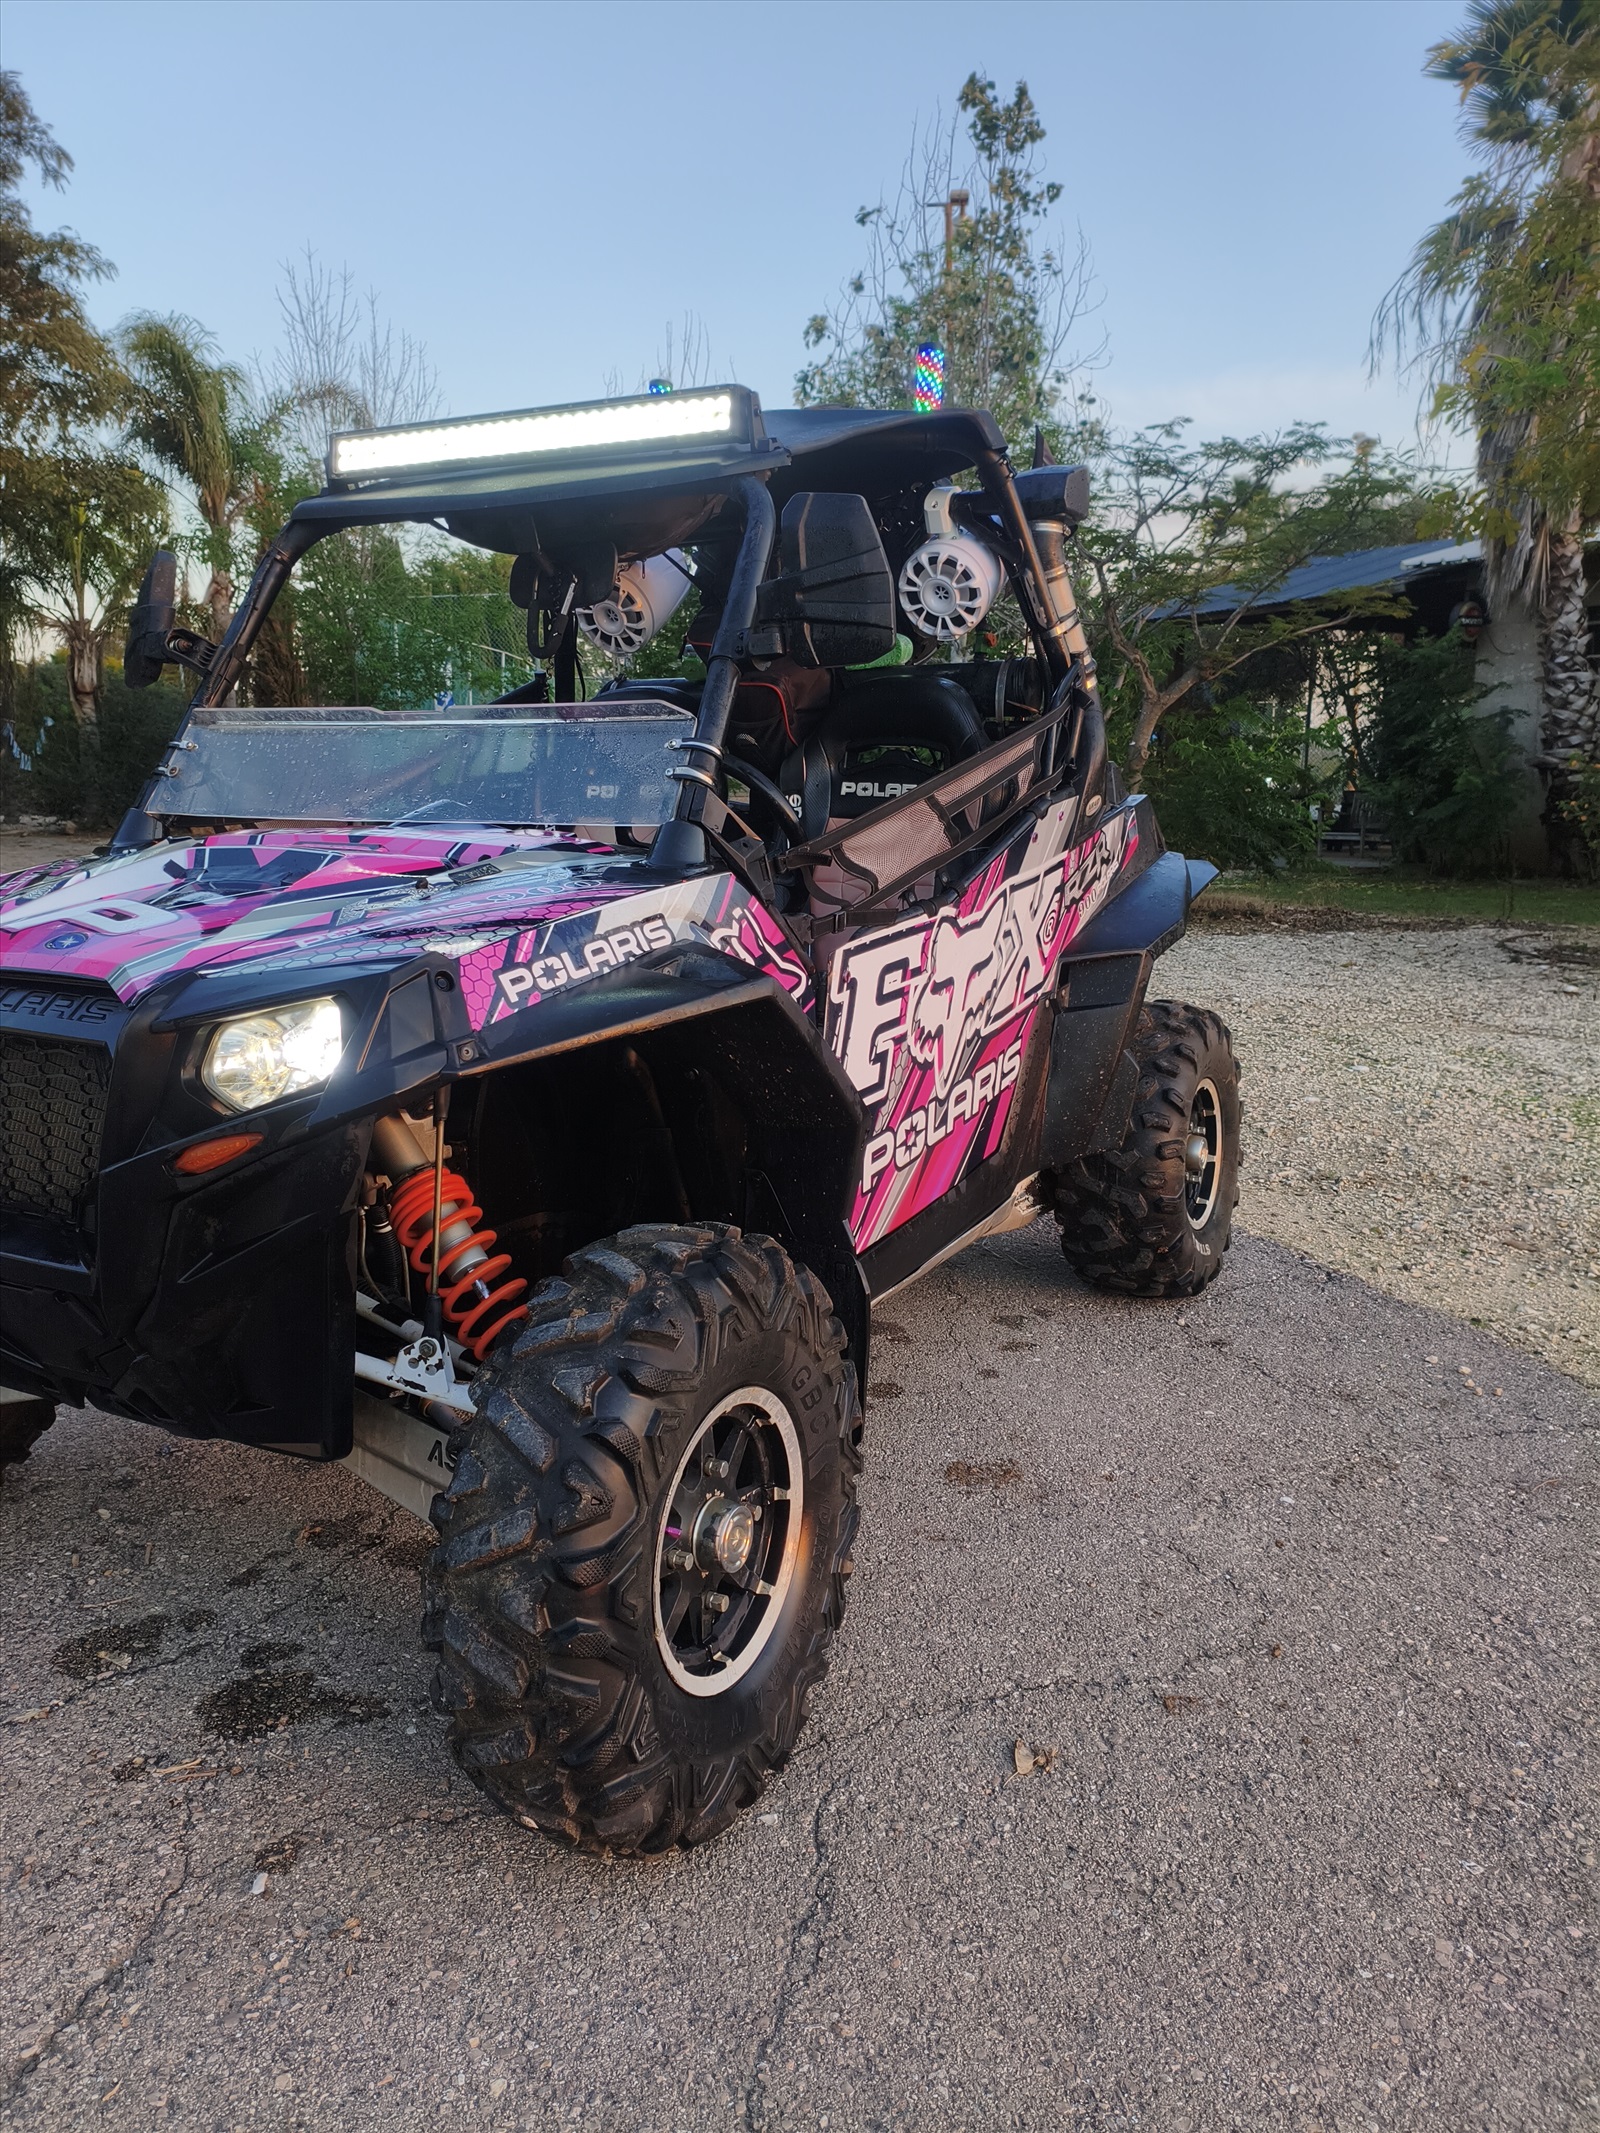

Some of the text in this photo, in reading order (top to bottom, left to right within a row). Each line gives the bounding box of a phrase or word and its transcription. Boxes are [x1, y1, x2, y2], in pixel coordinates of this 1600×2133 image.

[841, 782, 918, 797] POLA
[1064, 829, 1111, 907] RZR
[296, 901, 479, 948] POLARIS
[498, 919, 673, 1003] POLARIS
[862, 1039, 1022, 1194] POLARIS
[791, 1364, 830, 1435] GBC
